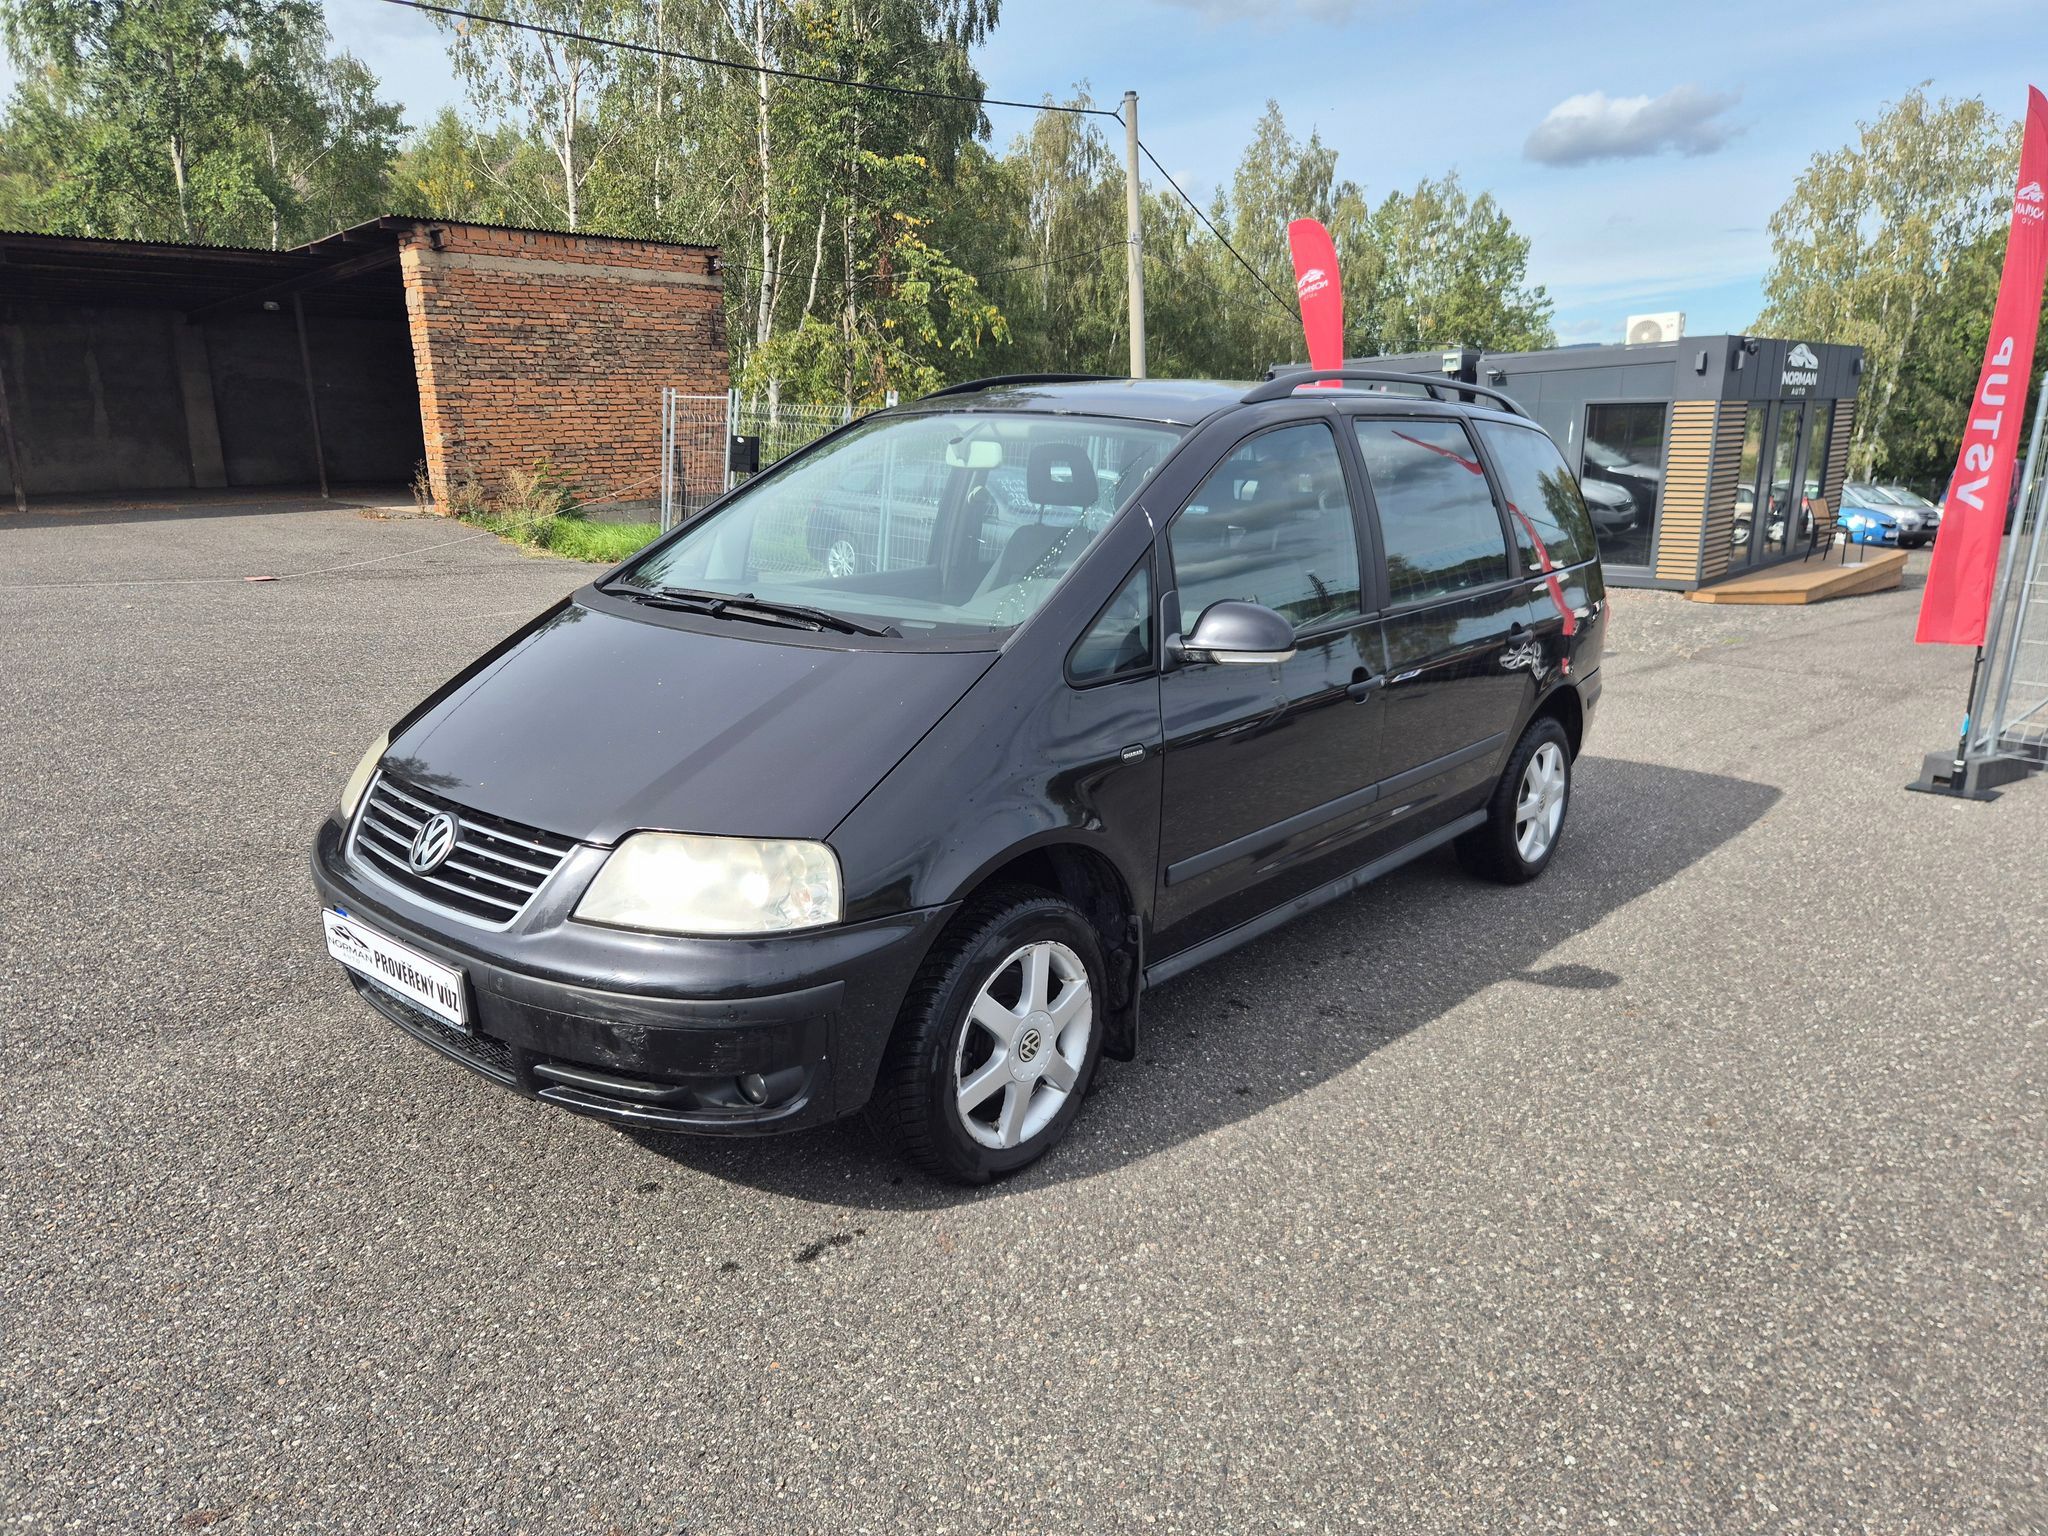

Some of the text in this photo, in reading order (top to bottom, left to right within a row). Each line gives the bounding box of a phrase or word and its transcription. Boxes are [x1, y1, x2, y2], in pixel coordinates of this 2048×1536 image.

[1781, 371, 1818, 386] NORMAN
[1791, 387, 1806, 396] AUTO
[328, 936, 373, 964] NORMAN
[374, 950, 434, 999] PROVĚŘENÝ
[436, 982, 459, 1012] VŮZ
